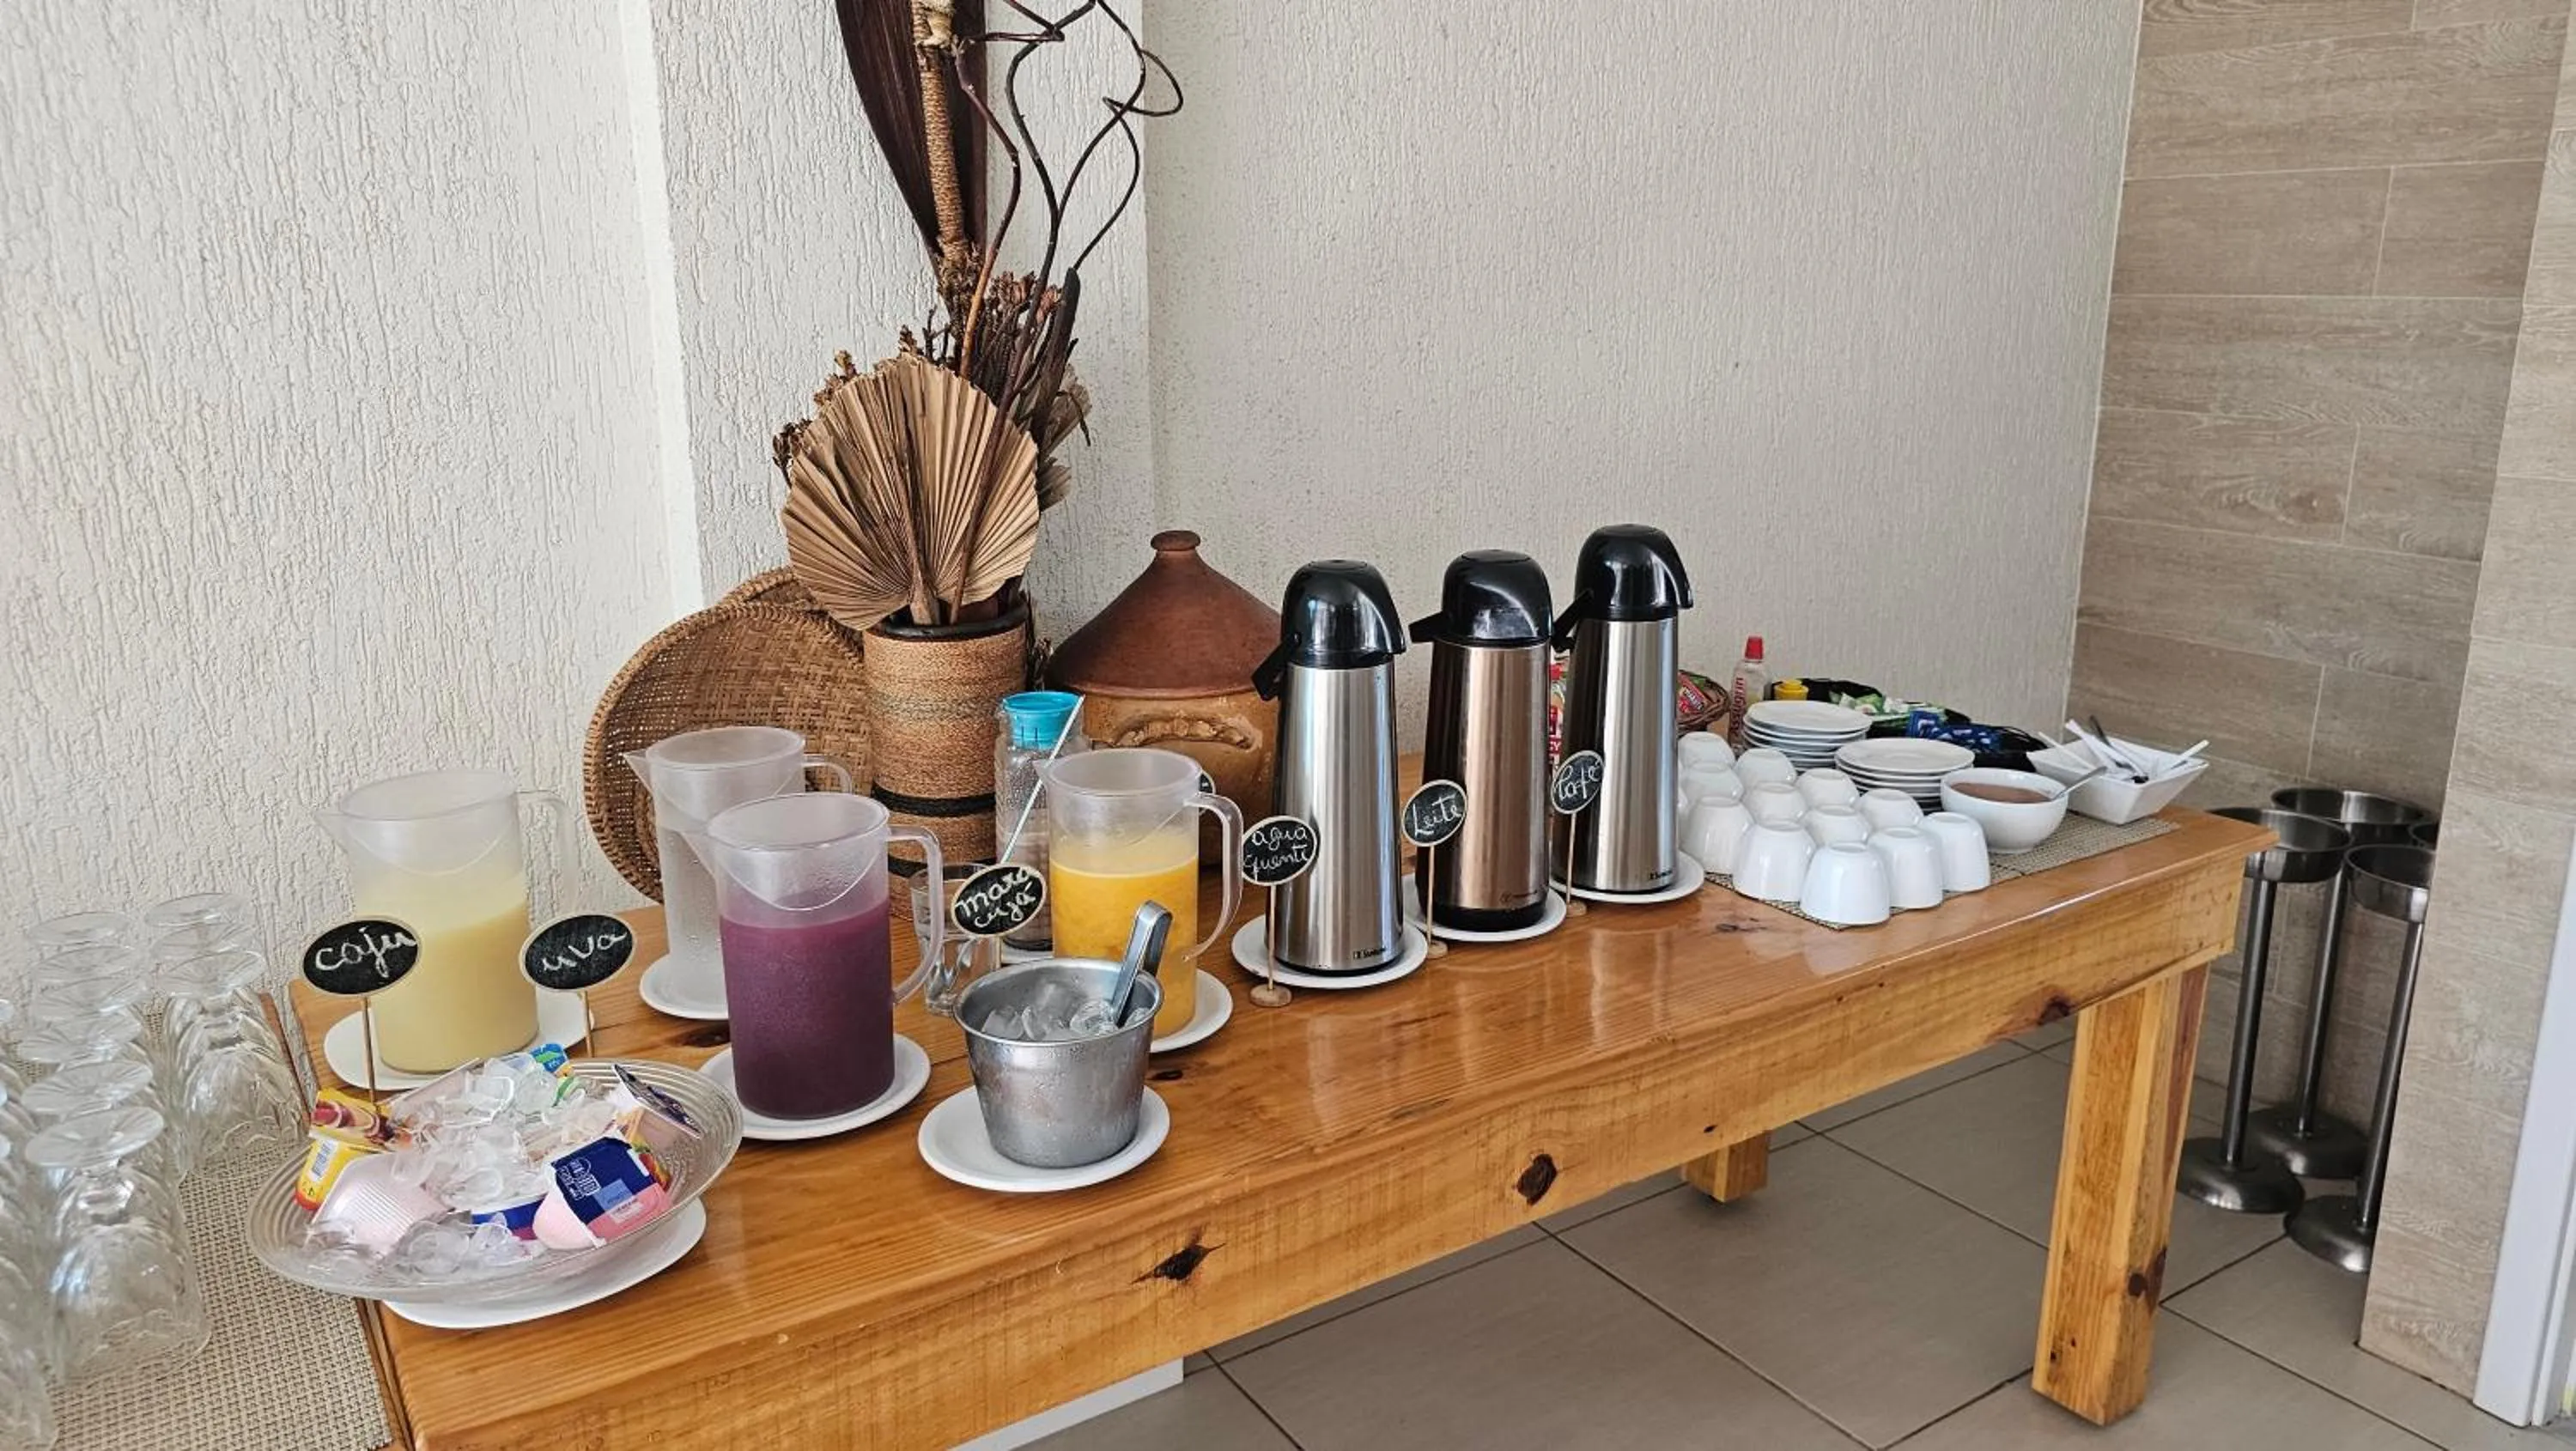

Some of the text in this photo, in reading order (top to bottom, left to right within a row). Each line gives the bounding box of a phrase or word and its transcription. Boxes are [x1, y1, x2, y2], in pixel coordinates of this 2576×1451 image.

[1413, 792, 1461, 837] Leite
[315, 926, 417, 978] caju
[542, 932, 628, 971] uva
